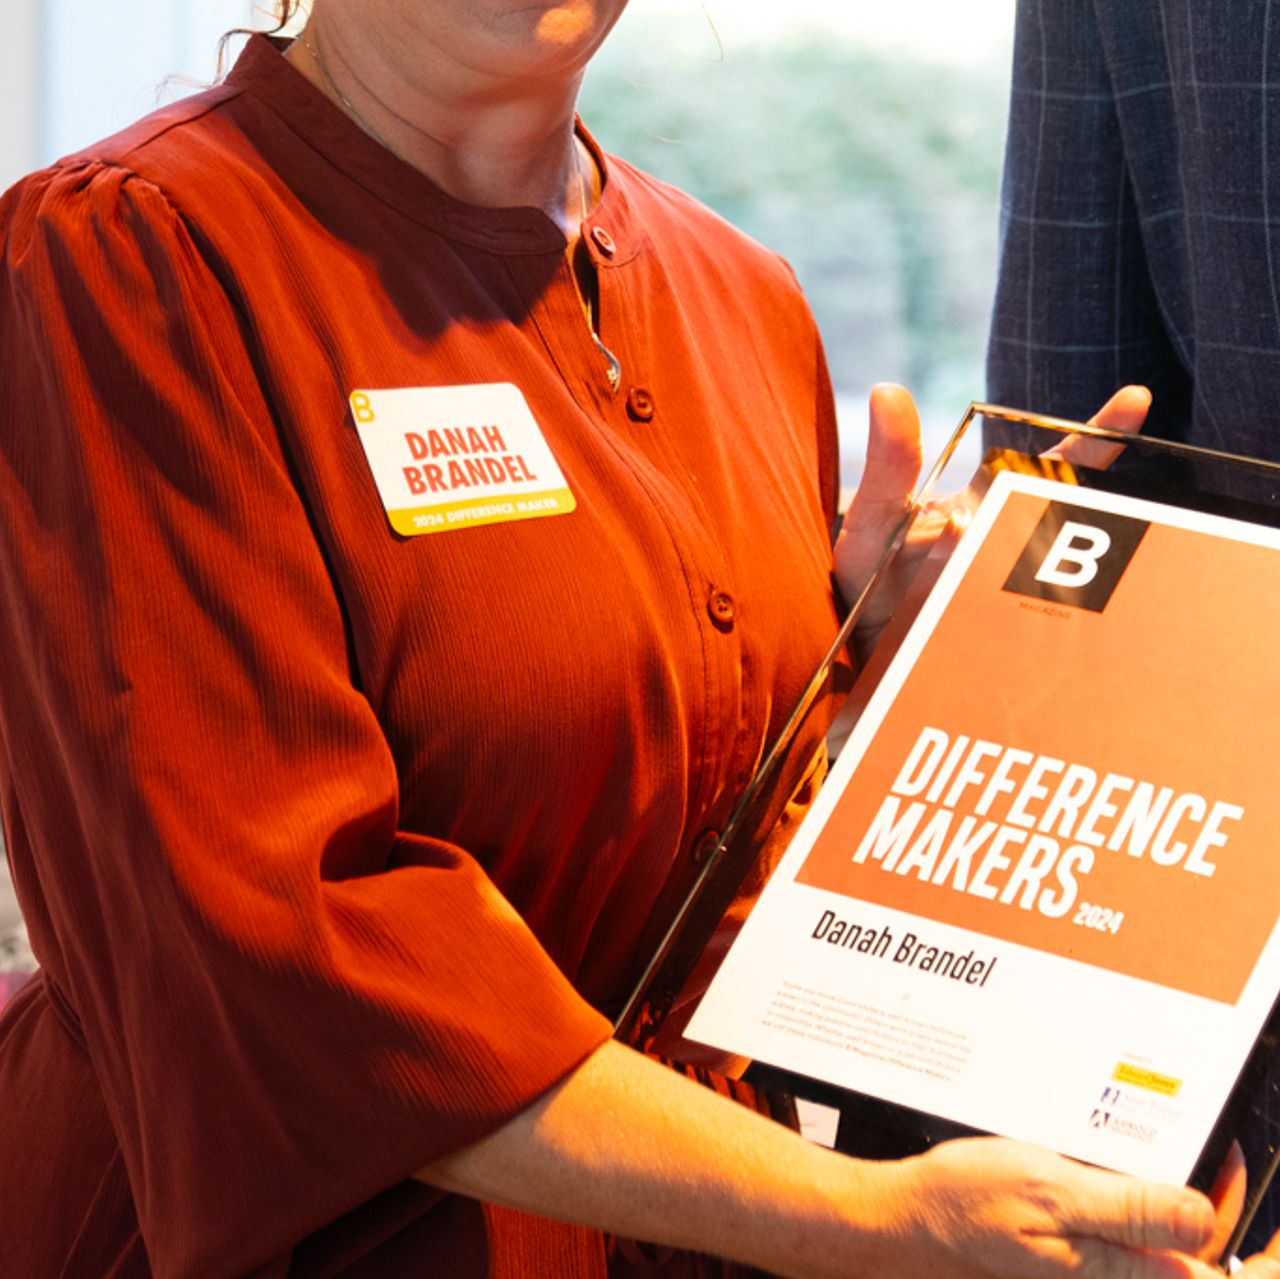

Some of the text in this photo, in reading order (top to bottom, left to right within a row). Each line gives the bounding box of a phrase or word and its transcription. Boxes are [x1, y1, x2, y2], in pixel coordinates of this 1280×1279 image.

[350, 391, 376, 423] B
[403, 425, 508, 461] DANAH
[401, 454, 538, 496] BRANDEL
[412, 497, 559, 529] 2024 DIFFERENCE MAKER
[1034, 519, 1112, 588] B
[1018, 602, 1072, 619] MAGAZINE
[890, 725, 1246, 877] DIFFERENCE
[851, 795, 1124, 934] MAKERS 2024
[810, 909, 998, 988] Danah Brandel
